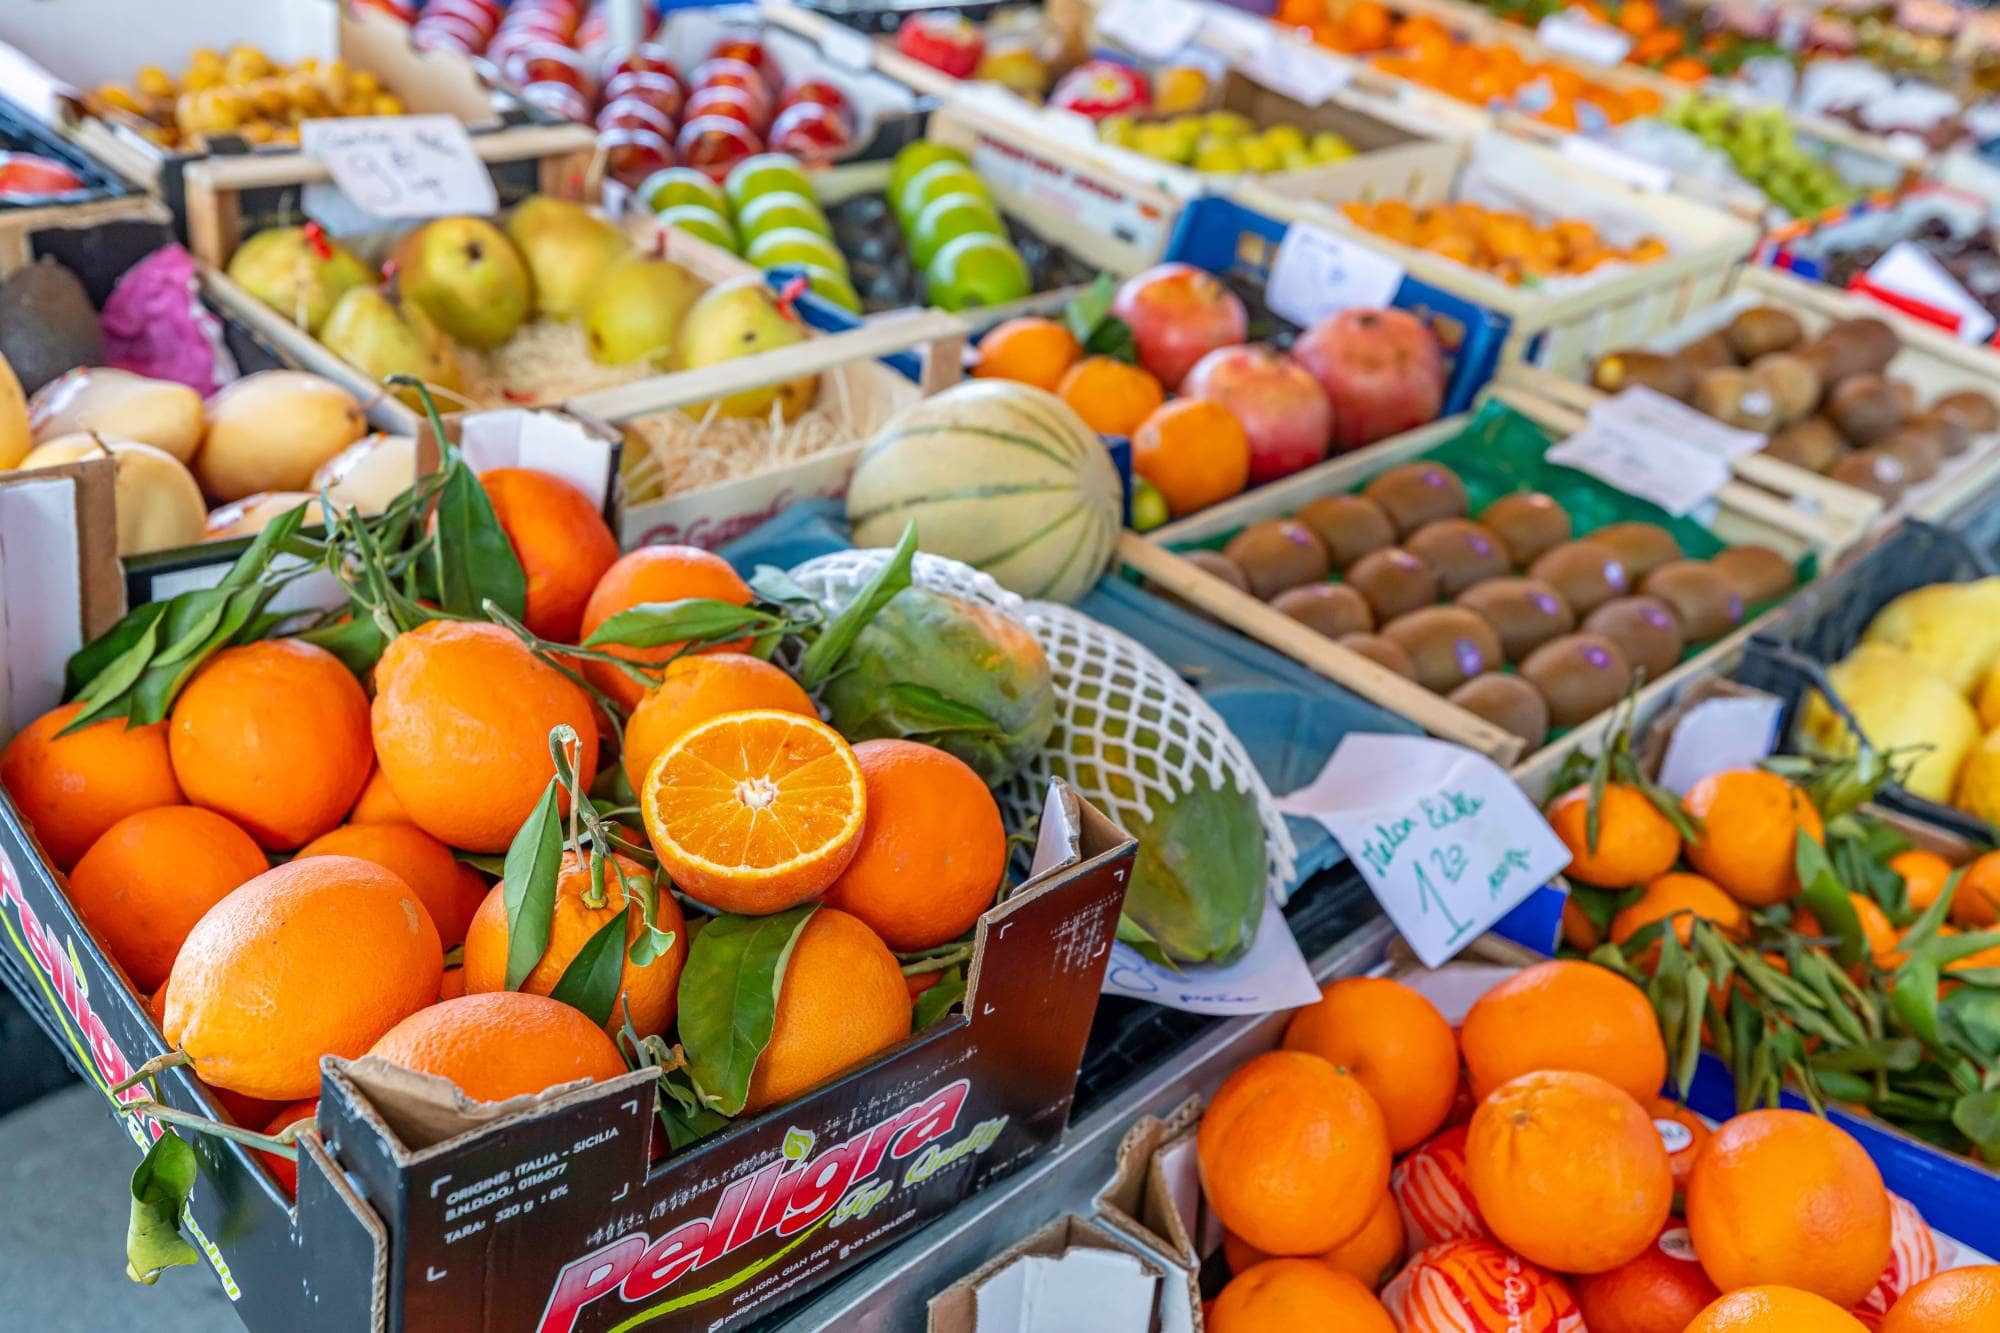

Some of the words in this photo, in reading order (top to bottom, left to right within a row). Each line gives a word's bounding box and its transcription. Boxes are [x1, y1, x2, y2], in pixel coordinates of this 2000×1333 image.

[514, 1152, 559, 1178] ITALIA
[573, 1127, 619, 1154] SICILIA
[518, 1162, 569, 1191] 0116677
[537, 1078, 971, 1333] Pelligra
[444, 1220, 487, 1245] TARA:
[732, 1274, 780, 1306] PELLIGRA
[782, 1258, 808, 1277] GIAN
[810, 1239, 840, 1262] FABIO
